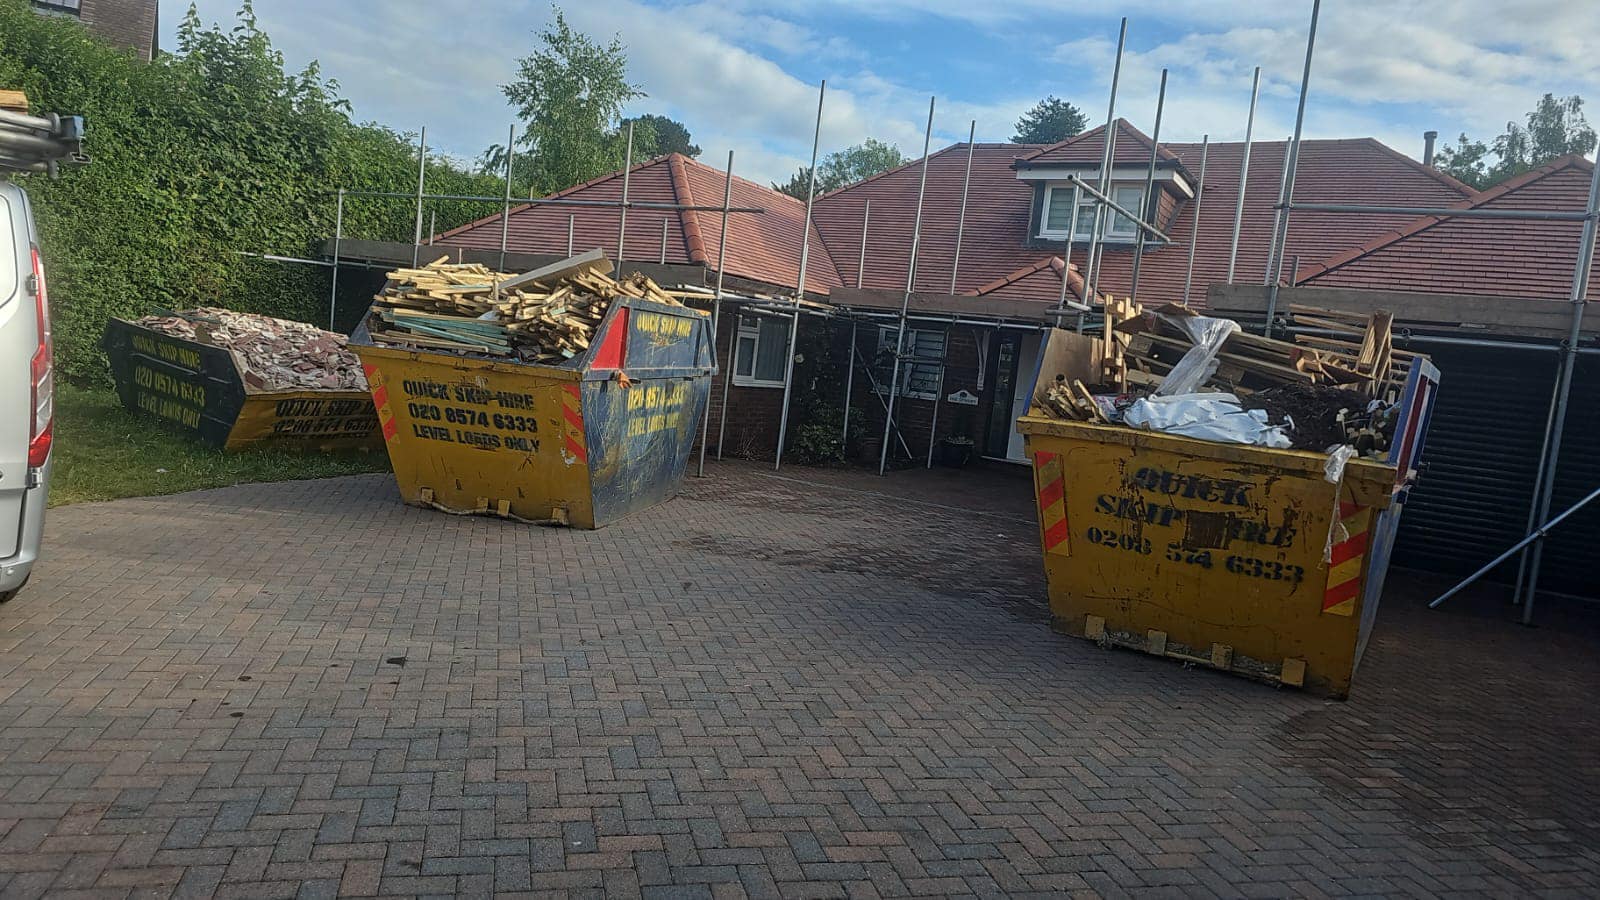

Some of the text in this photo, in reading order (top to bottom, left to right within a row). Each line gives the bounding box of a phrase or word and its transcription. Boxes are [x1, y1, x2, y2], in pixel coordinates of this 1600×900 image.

[135, 366, 153, 389] 020
[402, 379, 450, 400] QUICK
[494, 391, 535, 410] HIRE
[628, 387, 644, 411] 020
[408, 402, 538, 433] 020 8574 6333
[412, 424, 540, 453] LEVEL LOADS ONLY
[1134, 467, 1250, 507] QUICK
[1095, 494, 1184, 527] SKIP
[1087, 526, 1305, 584] 0208 574 6333
